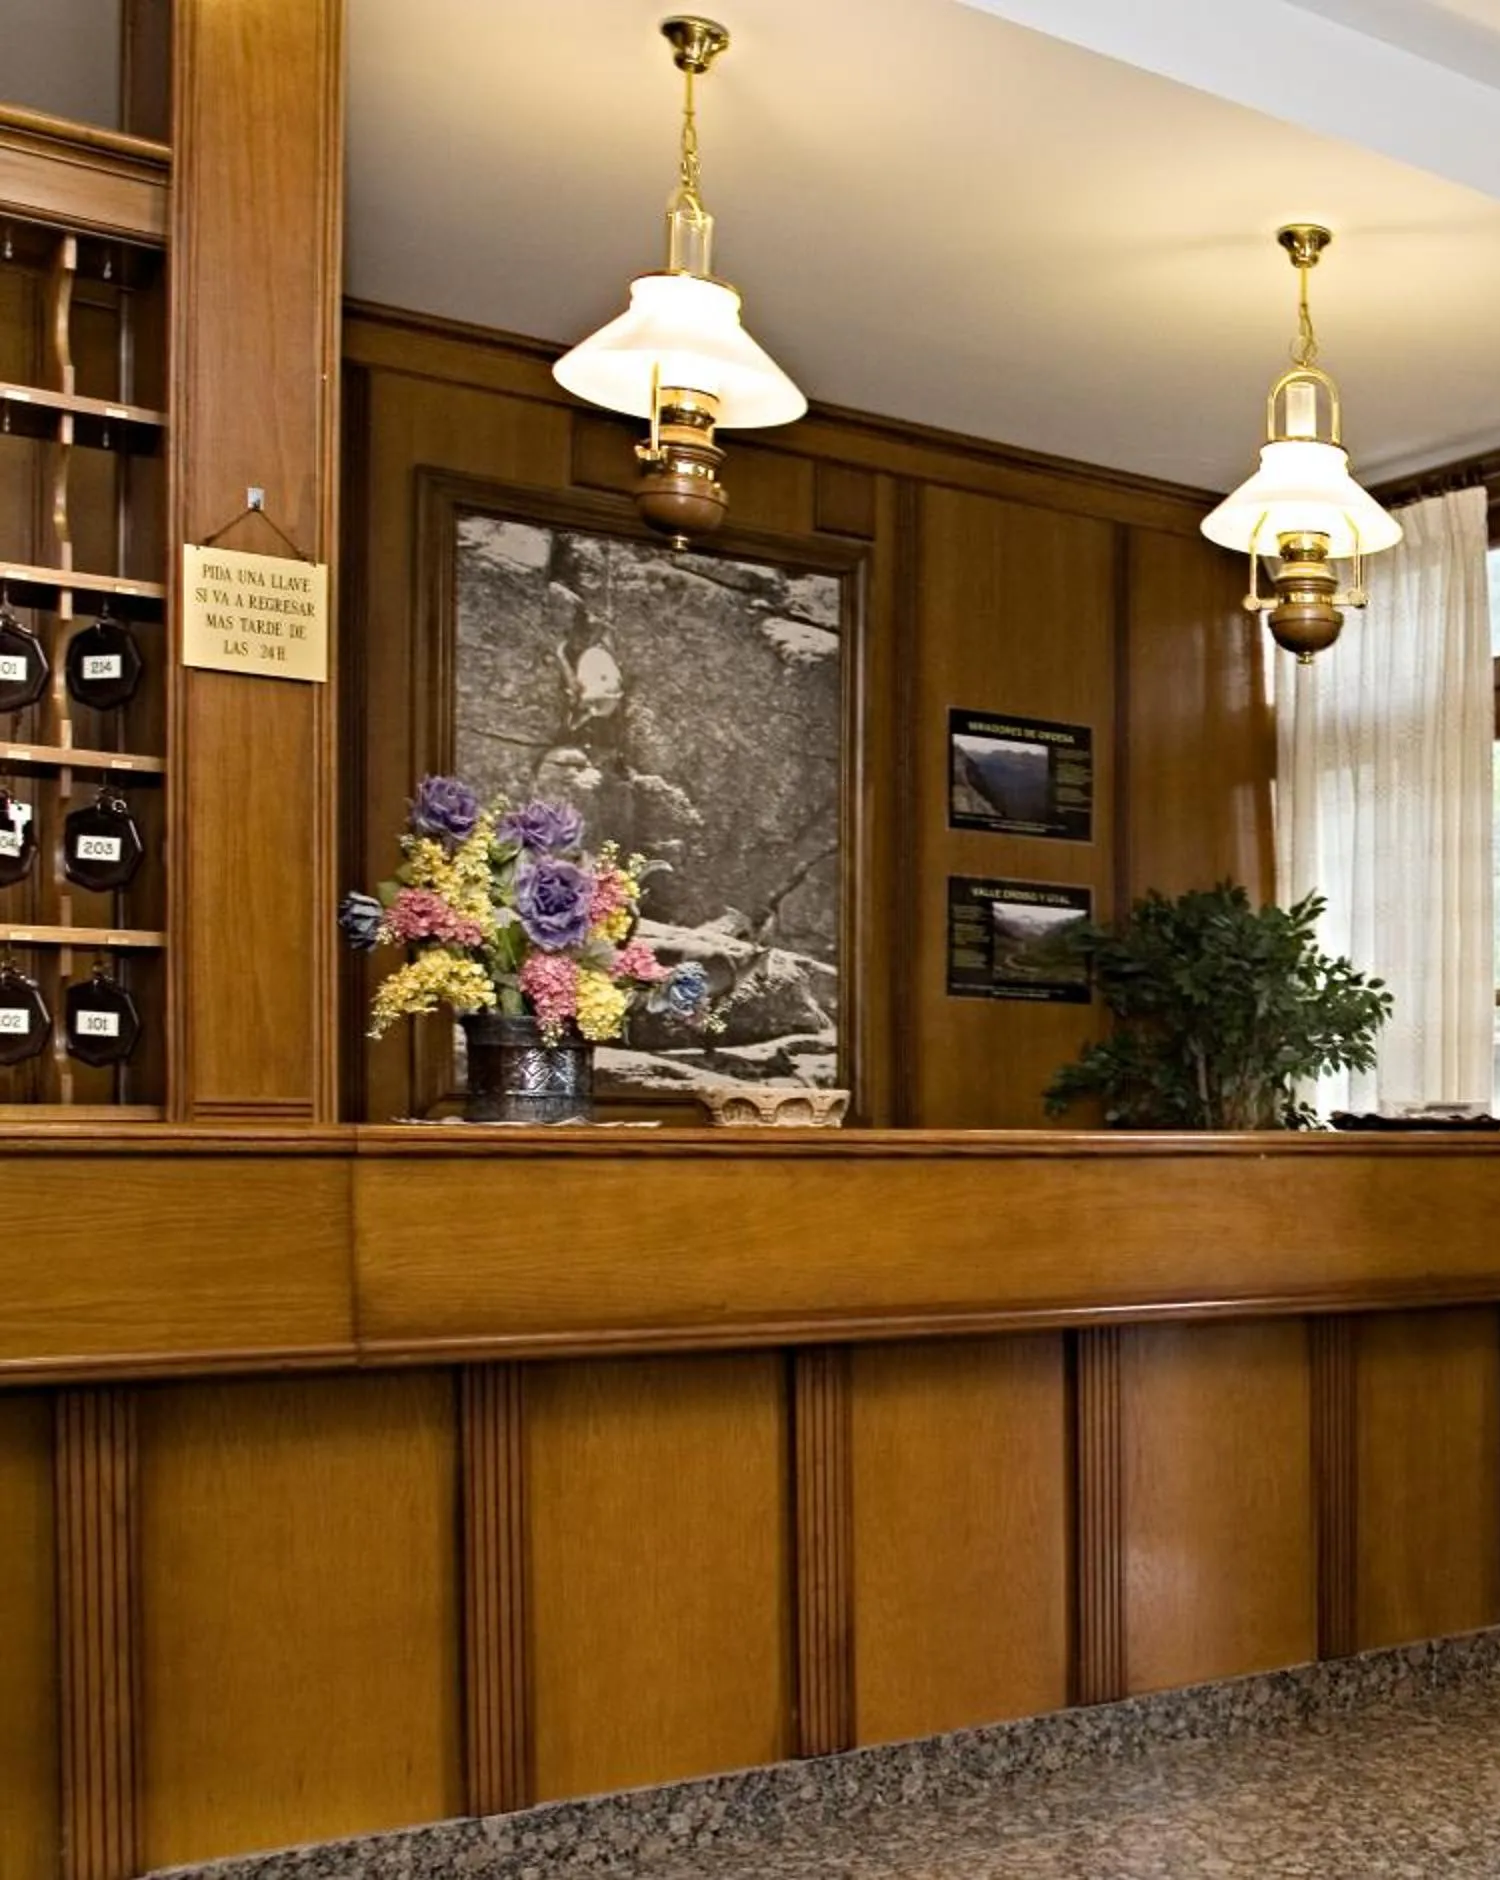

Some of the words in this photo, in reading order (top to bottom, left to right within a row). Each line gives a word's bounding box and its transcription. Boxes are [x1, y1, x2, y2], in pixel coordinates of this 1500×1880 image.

[202, 563, 232, 583] PIDA
[238, 569, 265, 587] UNA
[271, 573, 312, 593] LLAVE
[195, 588, 208, 603] SI
[213, 589, 230, 607] VA
[235, 594, 244, 608] A
[249, 595, 315, 617] REGRESAR
[206, 613, 234, 631] MAS
[240, 617, 283, 637] TARDE
[289, 623, 307, 641] DE
[223, 640, 249, 657] LAS
[83, 841, 114, 855] 203
